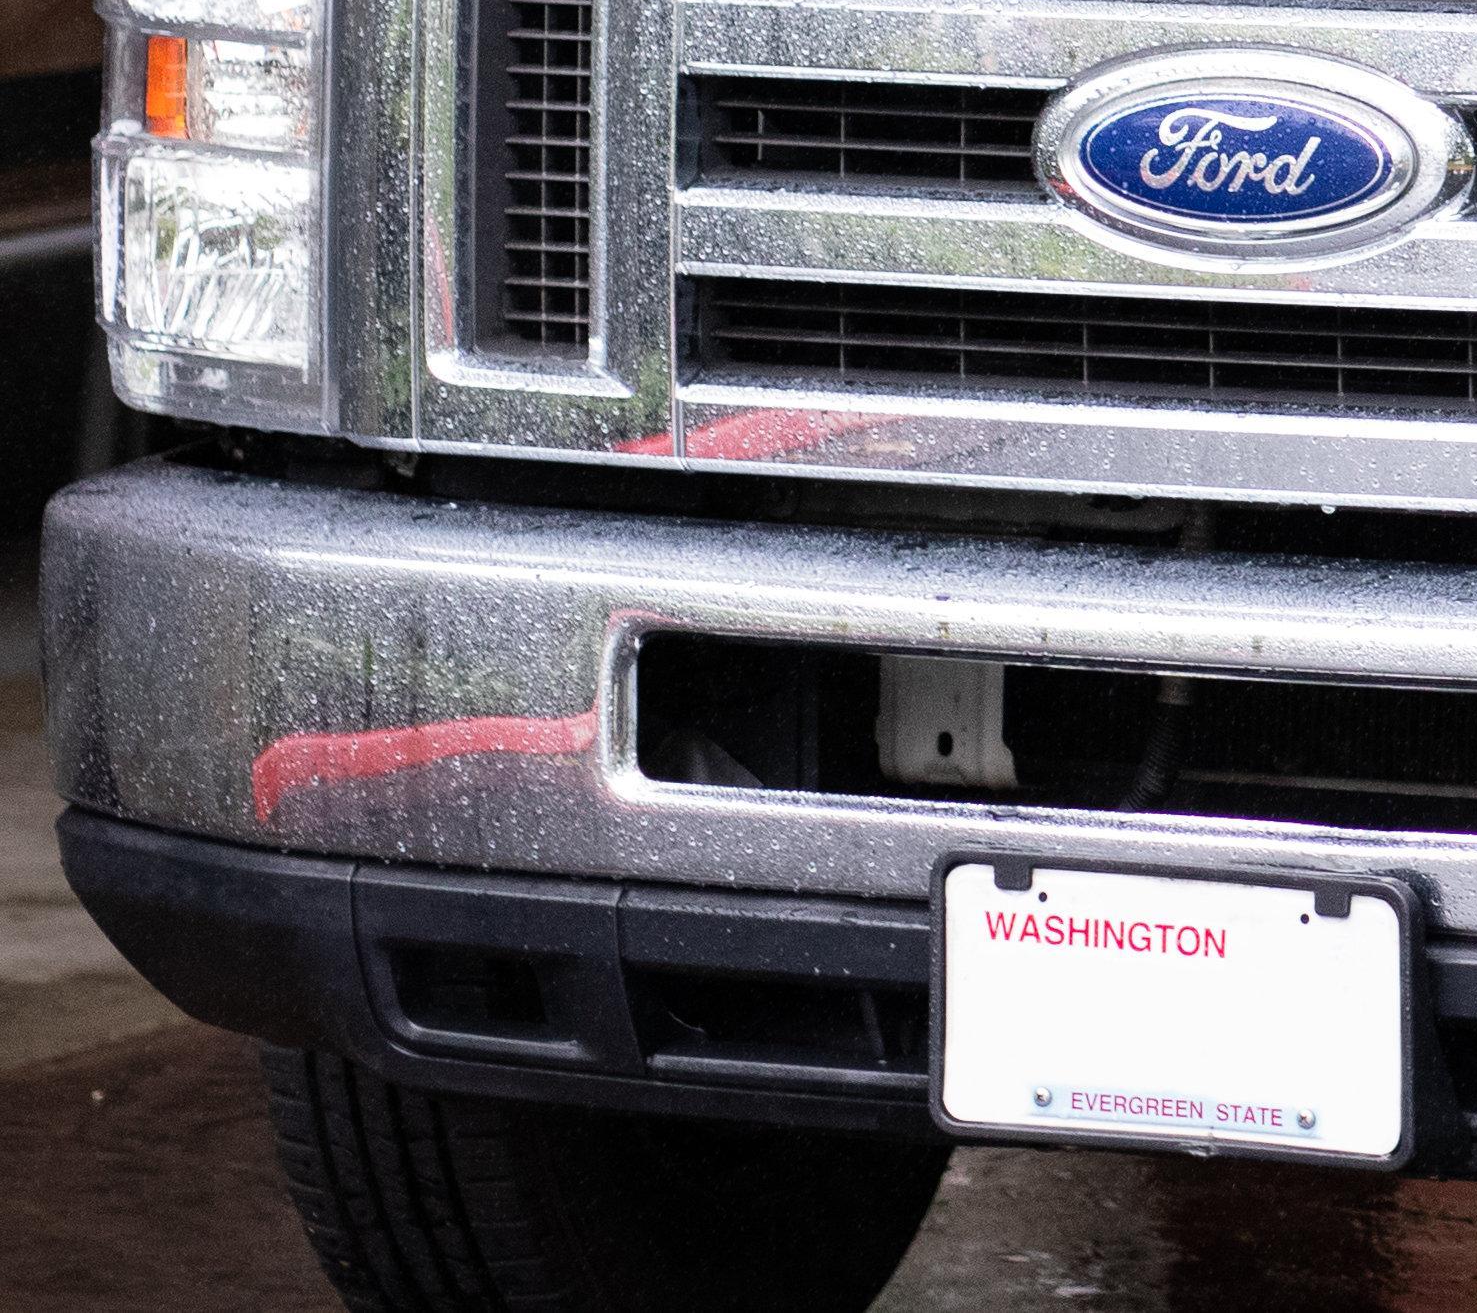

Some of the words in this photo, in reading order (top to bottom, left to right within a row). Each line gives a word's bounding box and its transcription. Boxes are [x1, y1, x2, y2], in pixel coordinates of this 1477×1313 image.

[1140, 106, 1322, 196] Ford
[984, 911, 1228, 959] WASHINGTON
[1071, 1092, 1204, 1120] EVERGREEN
[1216, 1103, 1283, 1128] STATE
